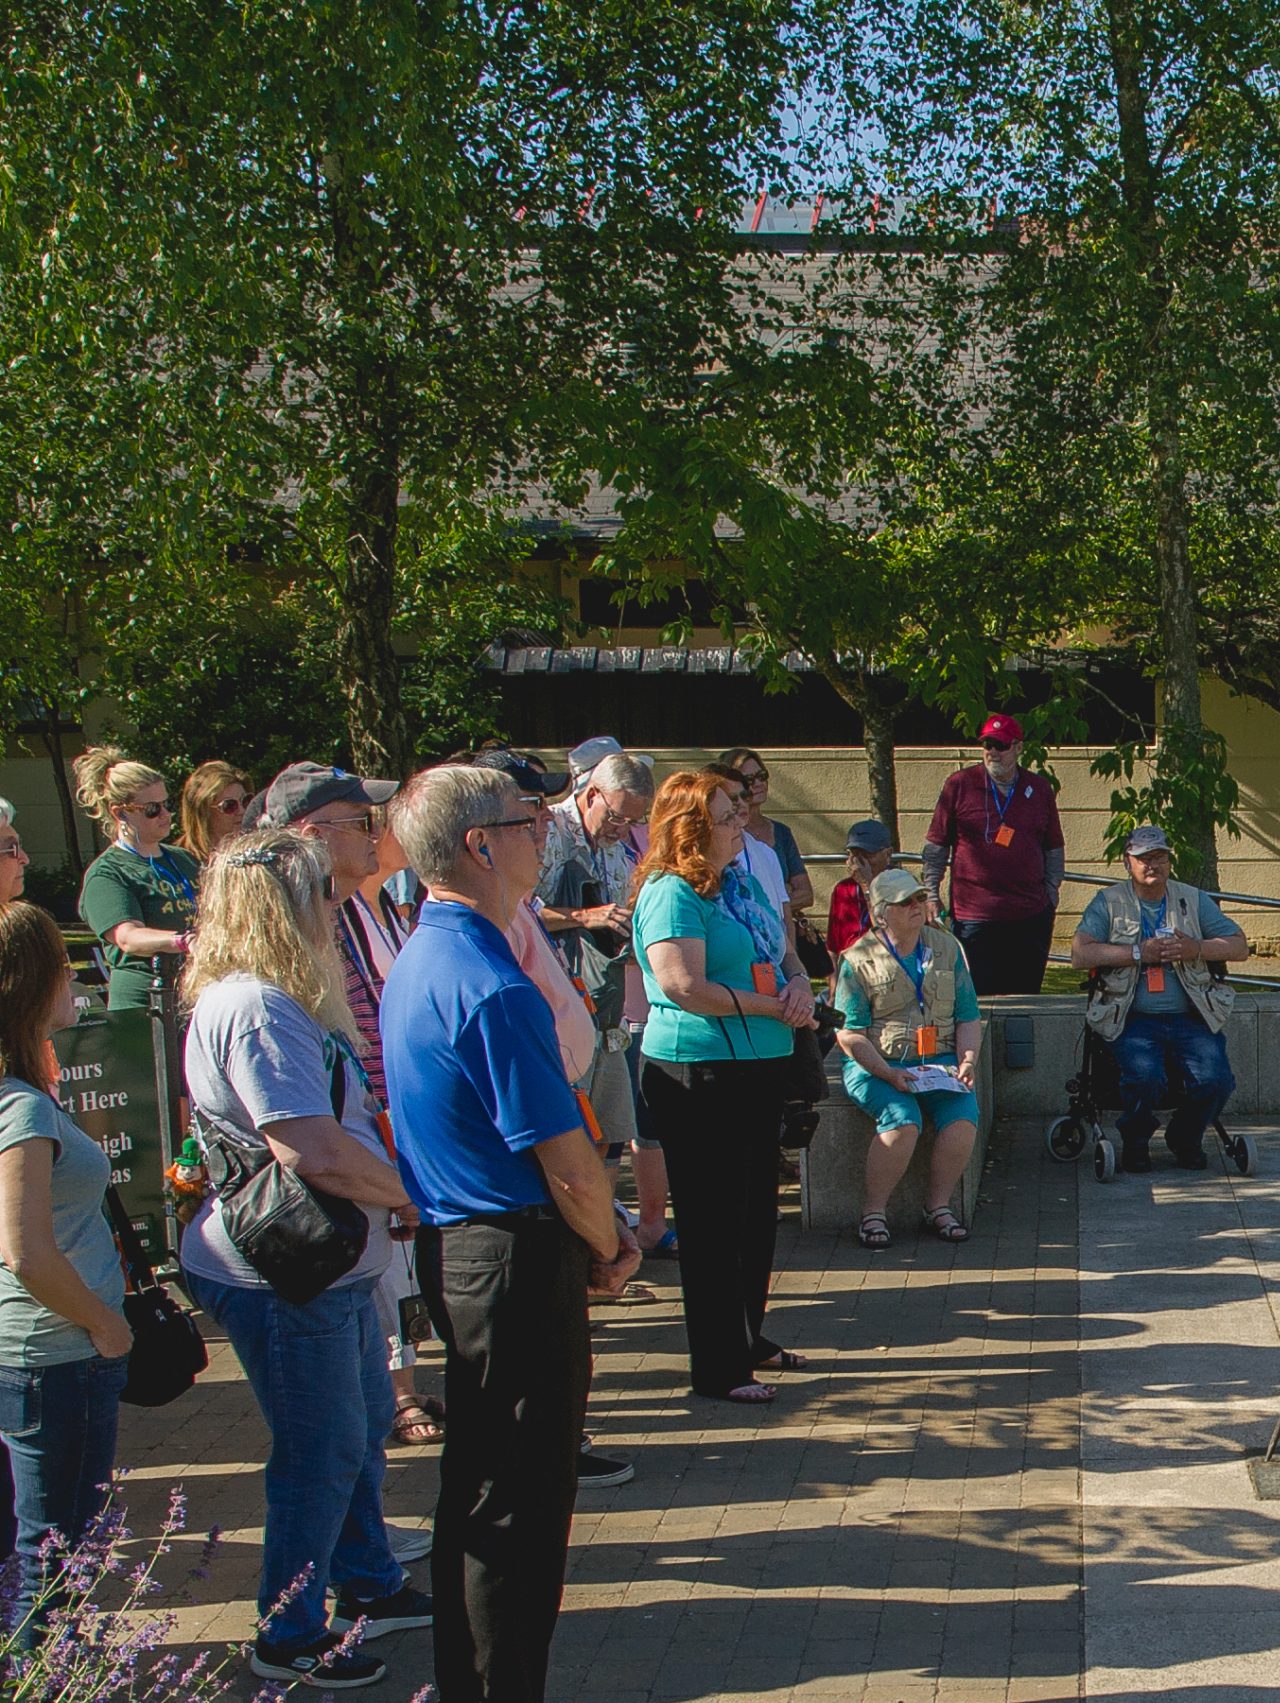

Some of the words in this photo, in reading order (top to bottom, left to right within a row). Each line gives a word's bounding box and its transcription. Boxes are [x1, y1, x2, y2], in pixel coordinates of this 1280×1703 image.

[61, 1063, 102, 1082] ours
[80, 1091, 128, 1112] Here
[98, 1132, 132, 1158] igh
[110, 1167, 131, 1187] as
